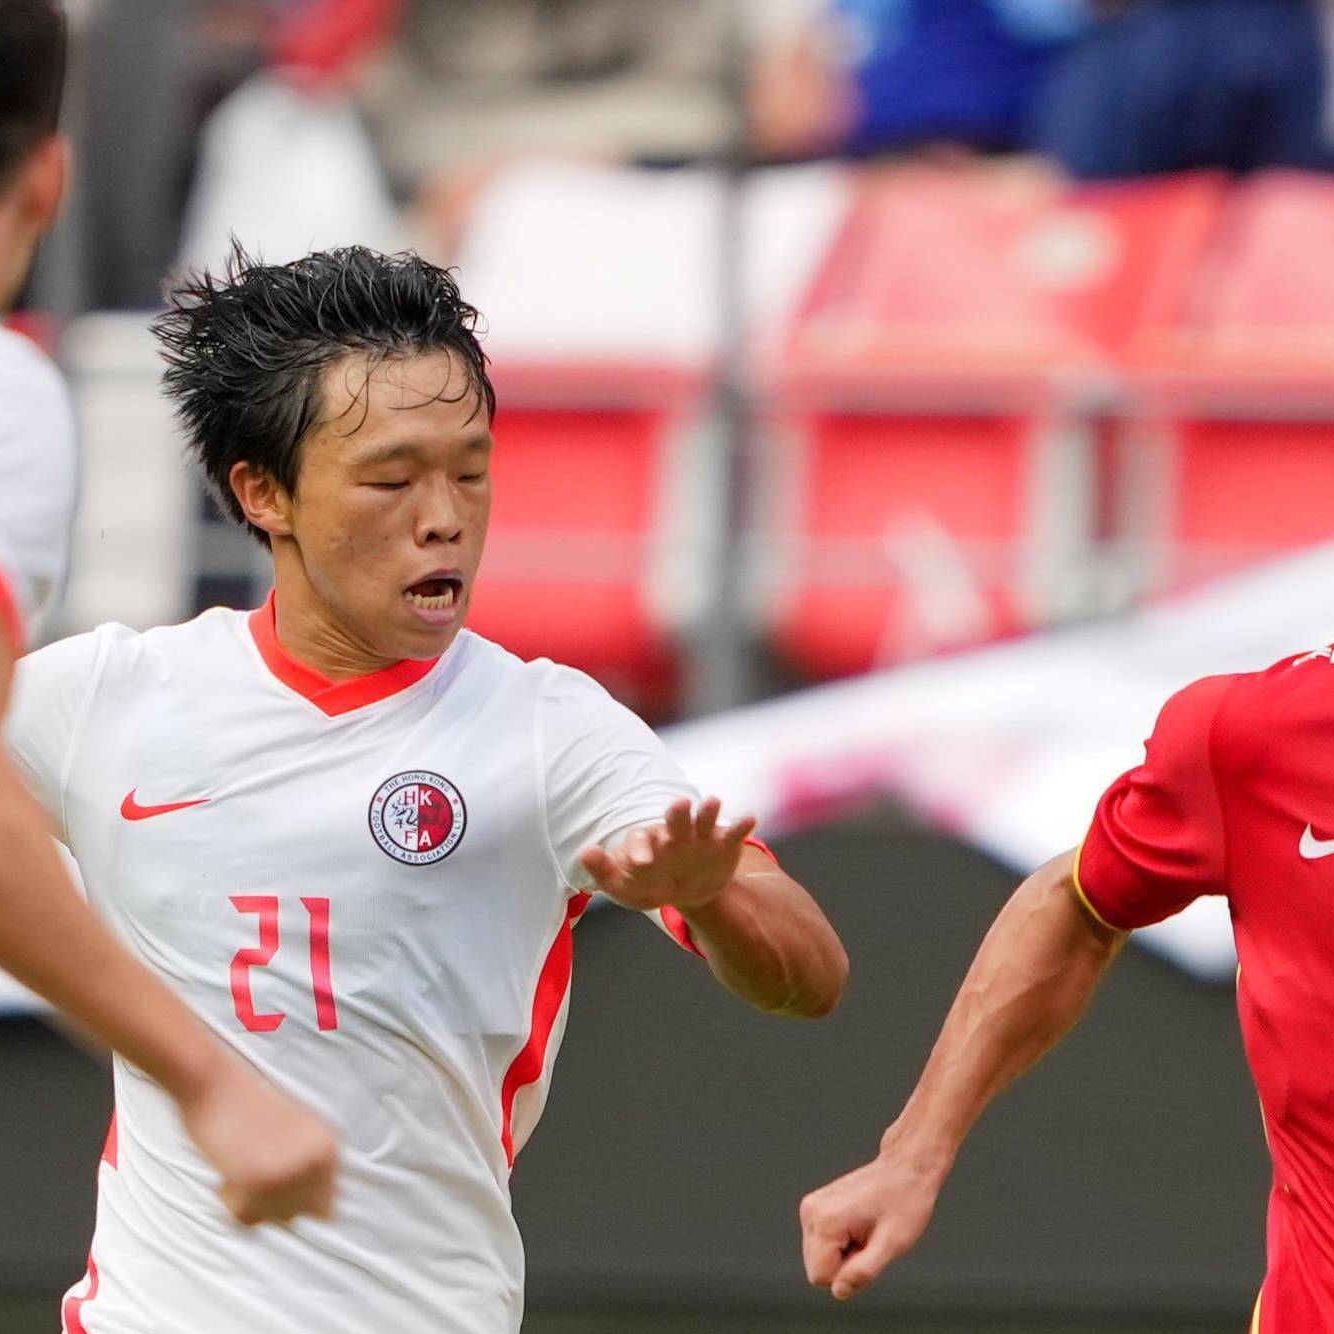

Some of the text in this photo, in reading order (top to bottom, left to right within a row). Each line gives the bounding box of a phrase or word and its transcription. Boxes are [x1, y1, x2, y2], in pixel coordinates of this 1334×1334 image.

[402, 774, 427, 783] HONG
[429, 776, 451, 793] KONG
[373, 810, 399, 856] FOOTBALL
[400, 832, 457, 862] ASSOCIATION
[228, 895, 338, 1033] 21
